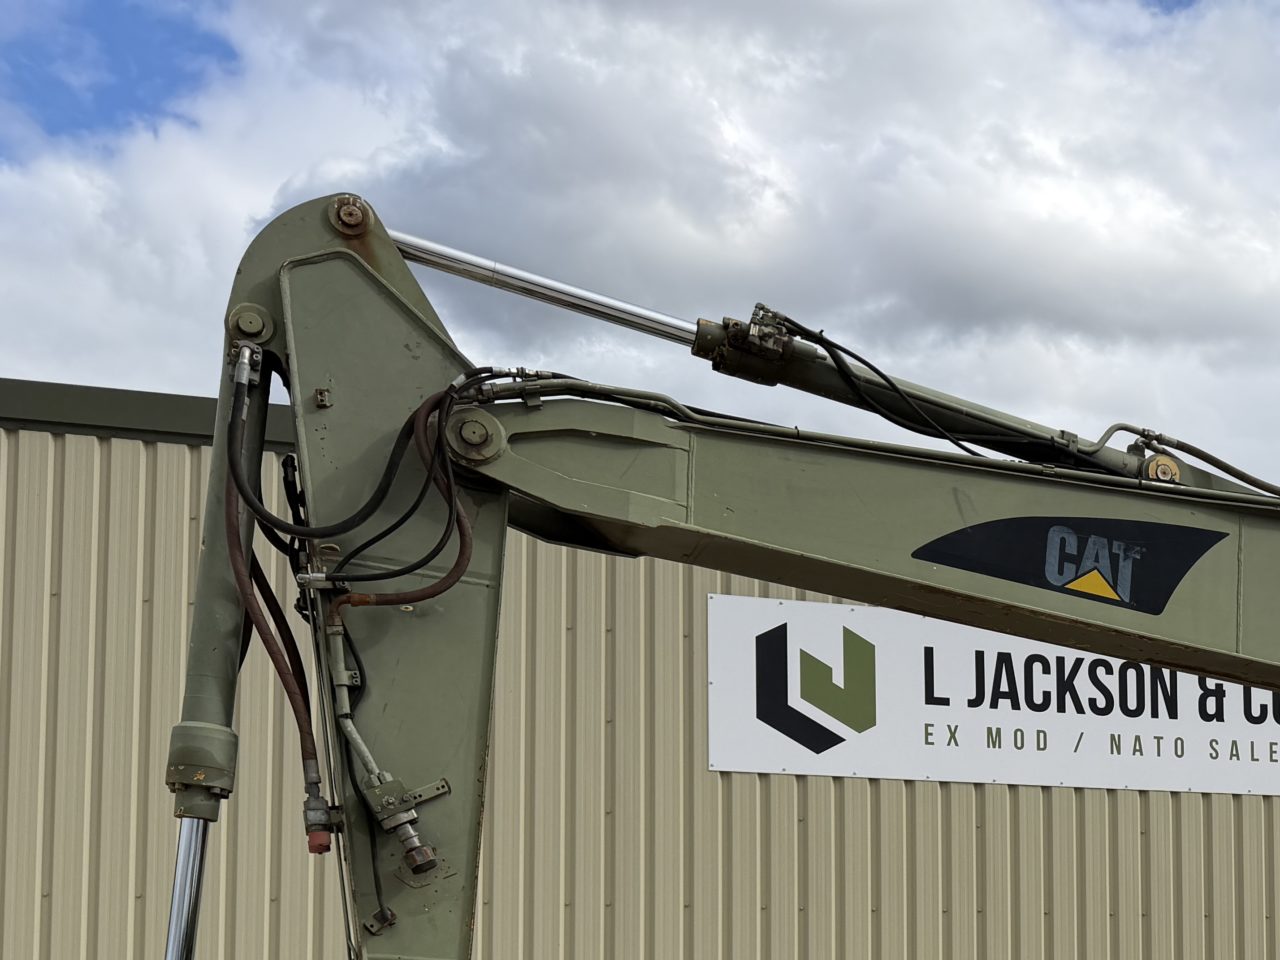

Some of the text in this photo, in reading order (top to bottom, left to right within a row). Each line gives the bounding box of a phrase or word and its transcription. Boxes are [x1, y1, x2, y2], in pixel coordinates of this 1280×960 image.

[1045, 525, 1141, 603] CAT
[923, 646, 950, 706] L
[966, 649, 1179, 720] JACKSON
[1198, 675, 1226, 723] &
[924, 722, 959, 747] EX
[986, 726, 1048, 752] MOD
[1110, 733, 1185, 758] NATO
